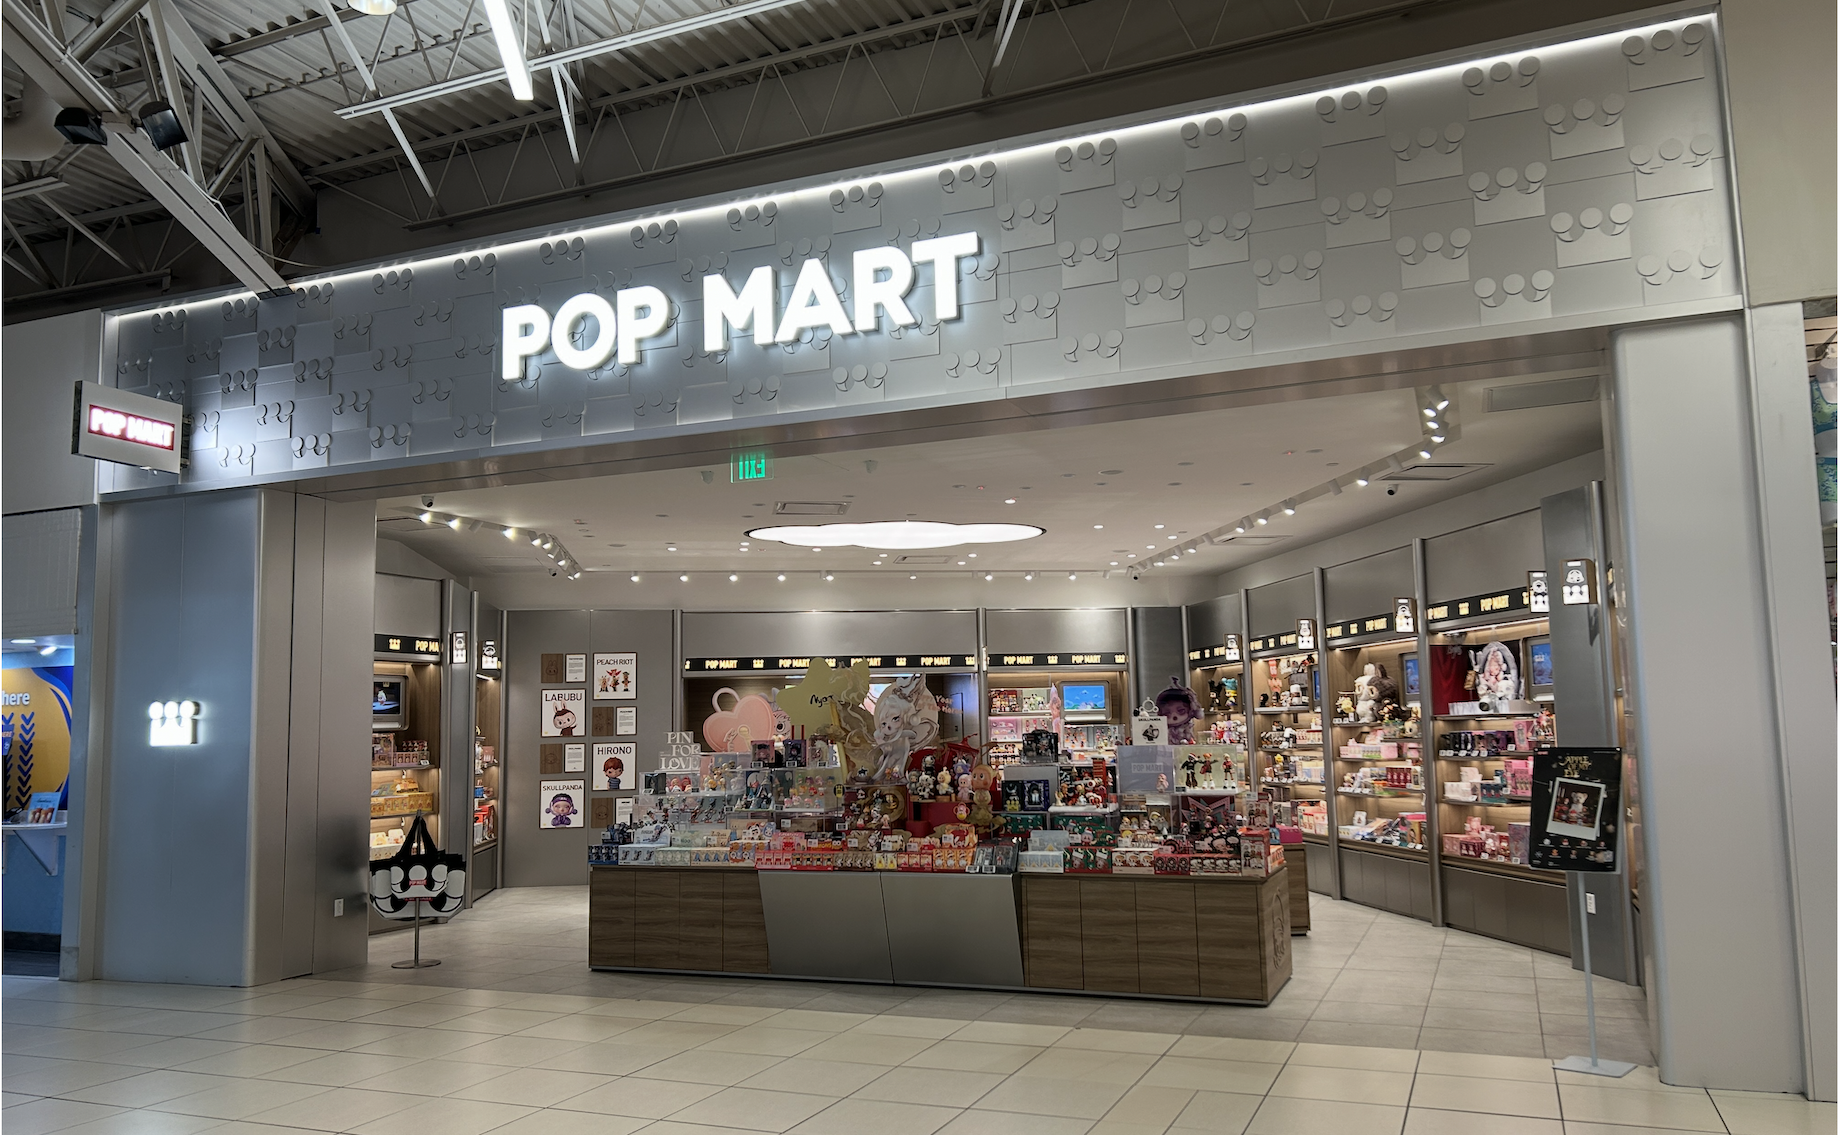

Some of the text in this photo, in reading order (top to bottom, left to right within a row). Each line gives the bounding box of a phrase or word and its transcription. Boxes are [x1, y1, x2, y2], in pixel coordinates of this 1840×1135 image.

[502, 231, 981, 381] POP MART
[90, 407, 174, 448] POP MART
[415, 640, 428, 651] POP
[596, 658, 634, 666] PEACH RIOT
[705, 660, 738, 669] POP MART
[779, 658, 810, 668] POP MART
[866, 657, 882, 666] ART
[921, 656, 951, 666] POP MART
[1003, 655, 1034, 665] POP MART
[1071, 655, 1084, 664] POP
[545, 692, 583, 702] LABUBU
[667, 731, 693, 744] PIN
[597, 746, 632, 755] HIRONO
[671, 744, 700, 757] FOR
[660, 756, 700, 769] LOVE
[542, 783, 583, 791] SKULLPANDA
